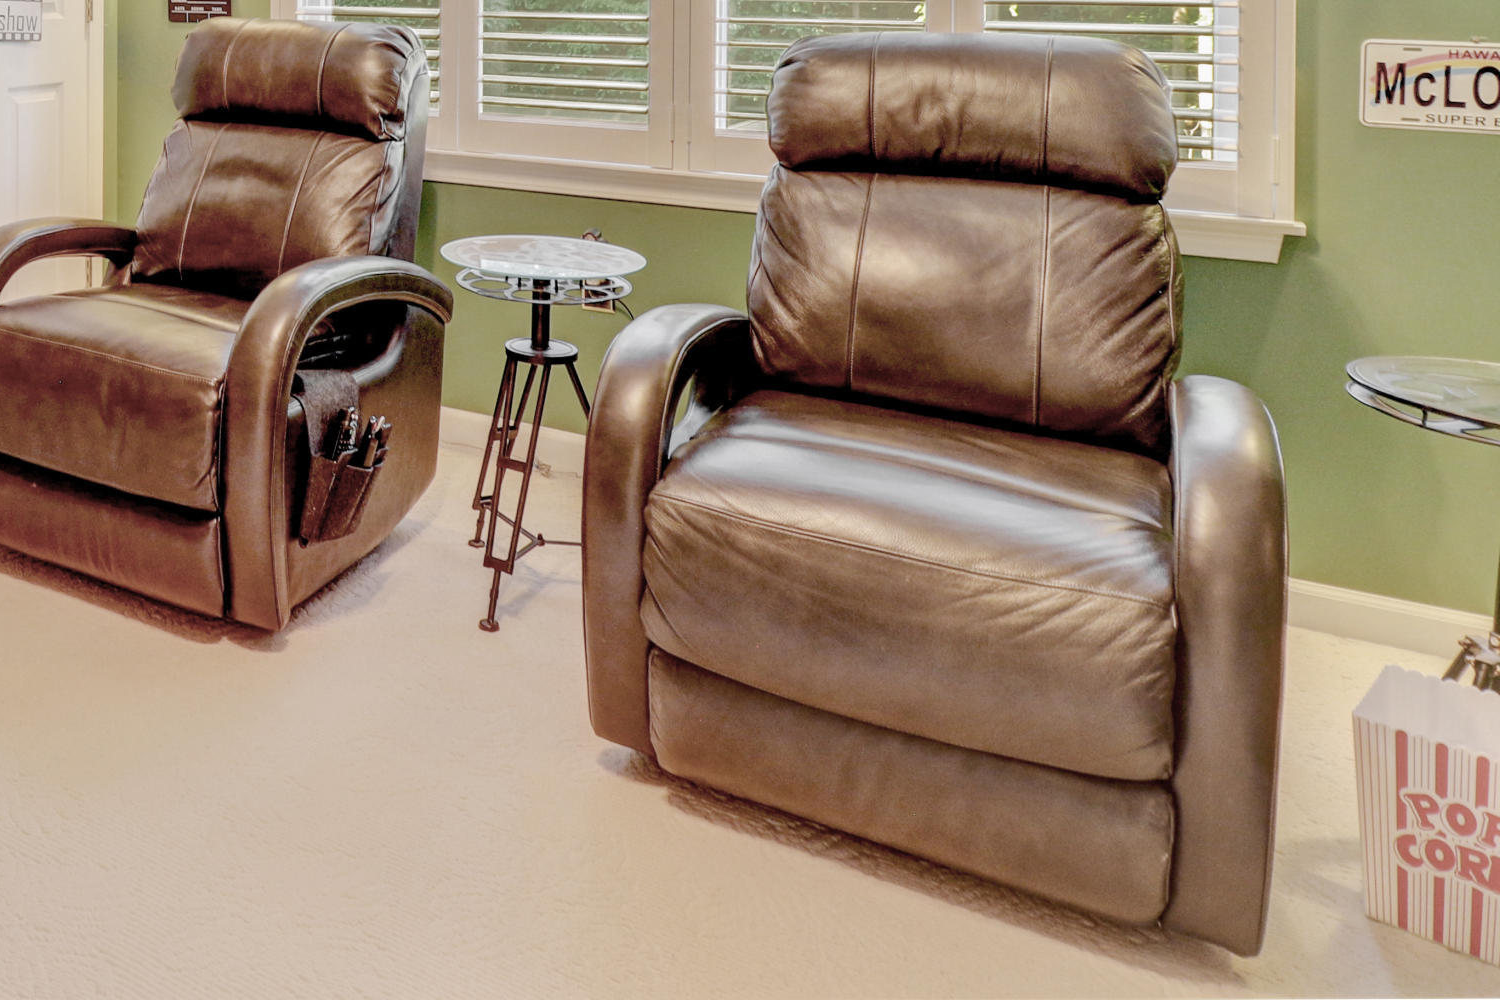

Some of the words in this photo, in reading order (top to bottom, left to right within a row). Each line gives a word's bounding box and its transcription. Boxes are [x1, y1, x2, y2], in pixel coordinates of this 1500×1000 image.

[1448, 48, 1500, 61] HAWA
[1374, 61, 1500, 110] McLO
[1426, 112, 1486, 127] SUPER
[1395, 834, 1500, 895] COR
